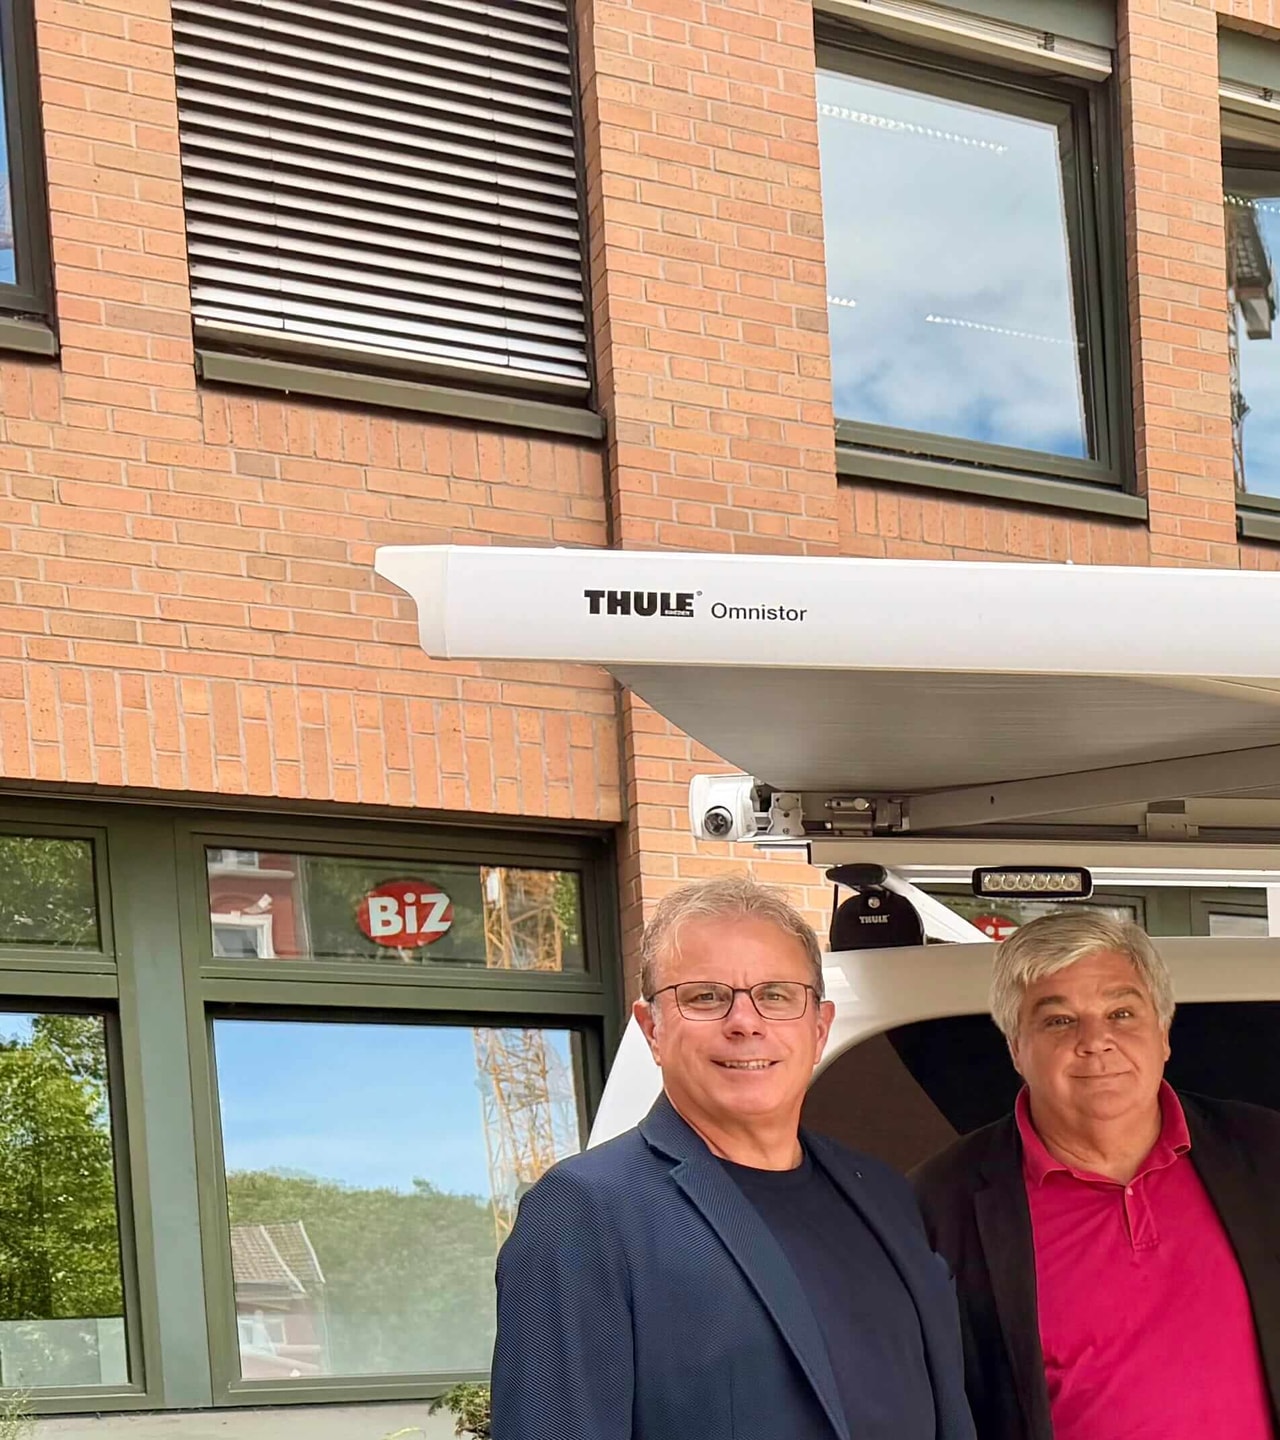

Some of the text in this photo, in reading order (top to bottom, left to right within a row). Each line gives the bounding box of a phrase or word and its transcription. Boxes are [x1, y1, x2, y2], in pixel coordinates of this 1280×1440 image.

[584, 589, 807, 622] THULE Omnistor
[367, 892, 452, 936] BiZ
[859, 915, 889, 924] THULE
